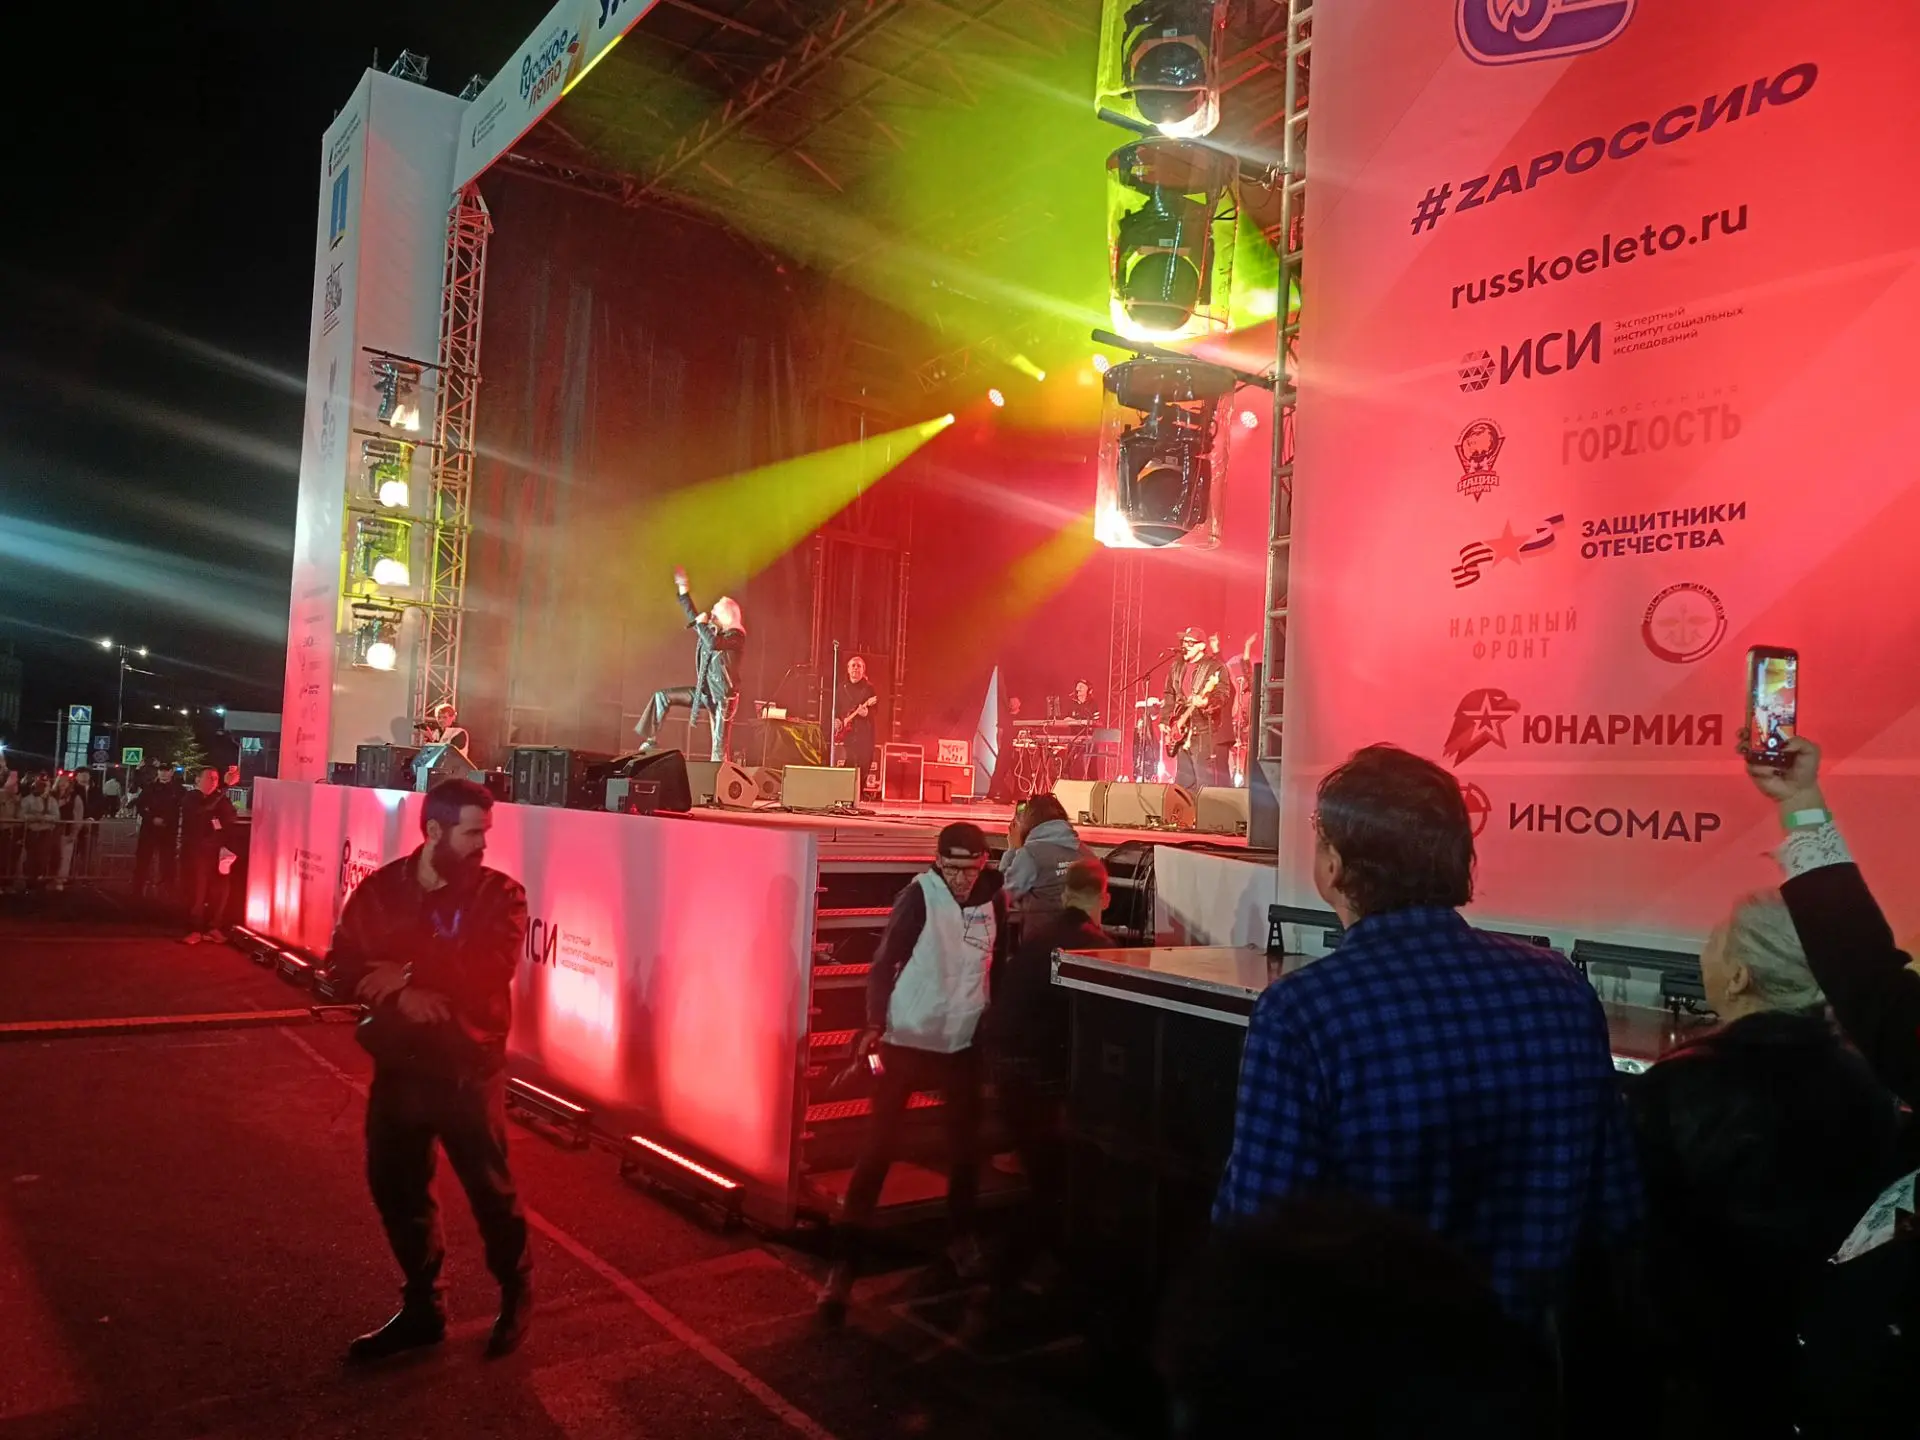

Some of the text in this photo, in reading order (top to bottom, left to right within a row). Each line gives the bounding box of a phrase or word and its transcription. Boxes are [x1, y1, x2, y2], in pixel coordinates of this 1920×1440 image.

[1451, 204, 1748, 309] russkoeleto.ru
[1613, 307, 1744, 344] институт социальных
[1614, 307, 1686, 330] Экспертный
[1500, 322, 1602, 386] ИСИ
[1613, 329, 1699, 355] исследований
[1562, 402, 1742, 466] ГОРДОСТЬ
[1581, 501, 1746, 539] ЗАЩИТНИКИ
[1580, 528, 1725, 560] ОТЕЧЕСТВА
[1449, 606, 1578, 639] НАРОДНЫЙ
[1472, 636, 1551, 661] ФРОНТ
[1522, 713, 1723, 746] ЮНАРМИЯ
[1509, 802, 1721, 843] ИНСОМАР
